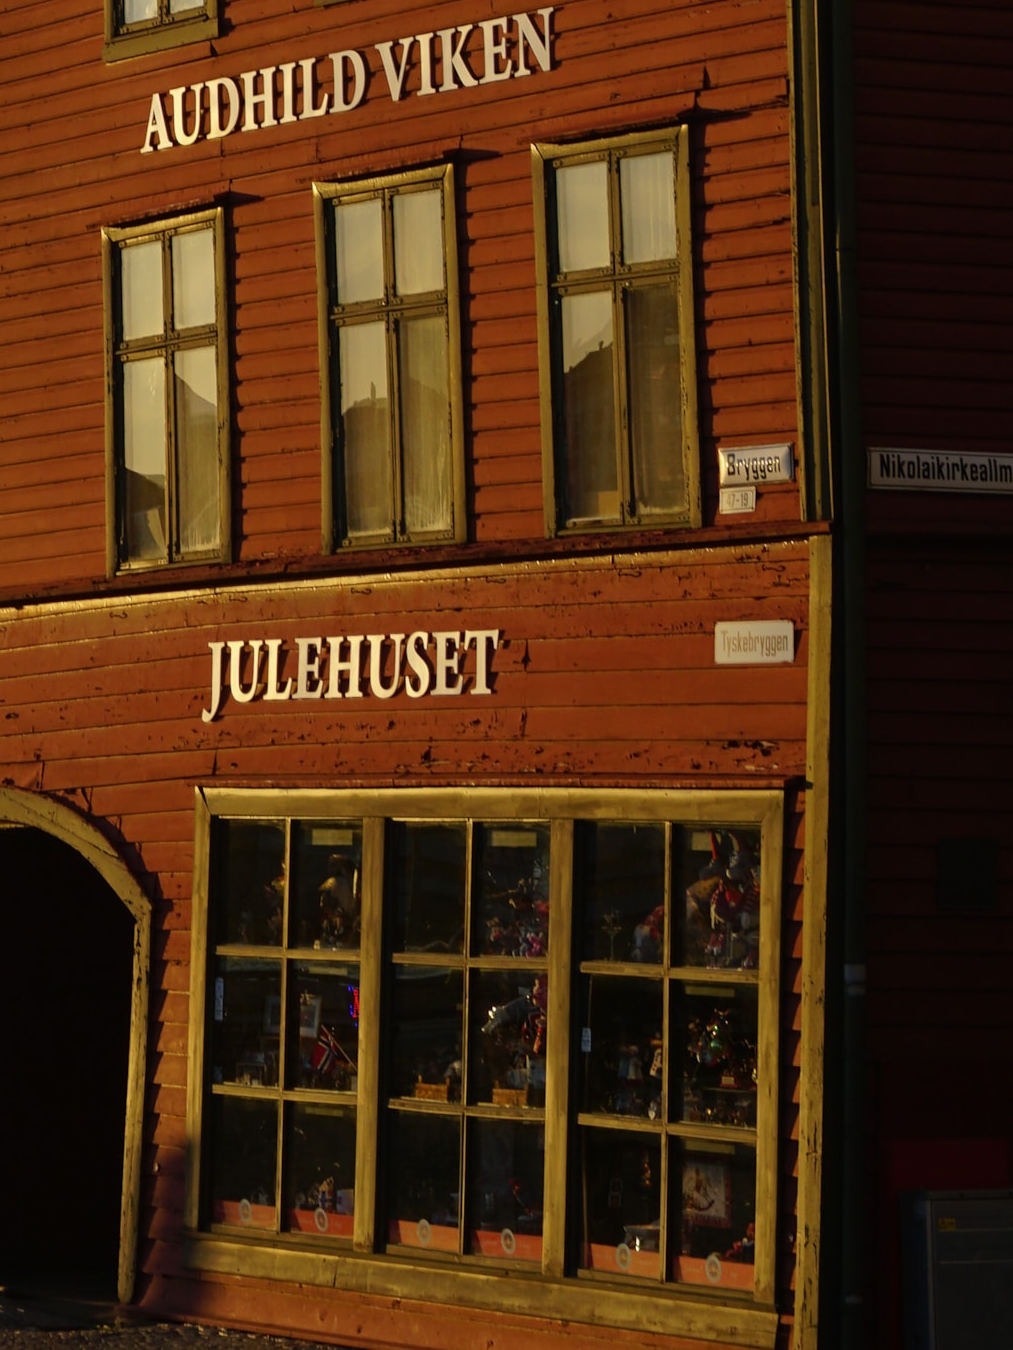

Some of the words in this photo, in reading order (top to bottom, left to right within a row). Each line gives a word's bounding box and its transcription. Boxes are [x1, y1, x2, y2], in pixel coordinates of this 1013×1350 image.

[140, 50, 367, 154] AUDHILD
[375, 6, 555, 102] VIKEN
[726, 453, 781, 481] Bryggen
[721, 630, 789, 658] Tyskebryggen
[201, 629, 500, 723] JULEHUSET
